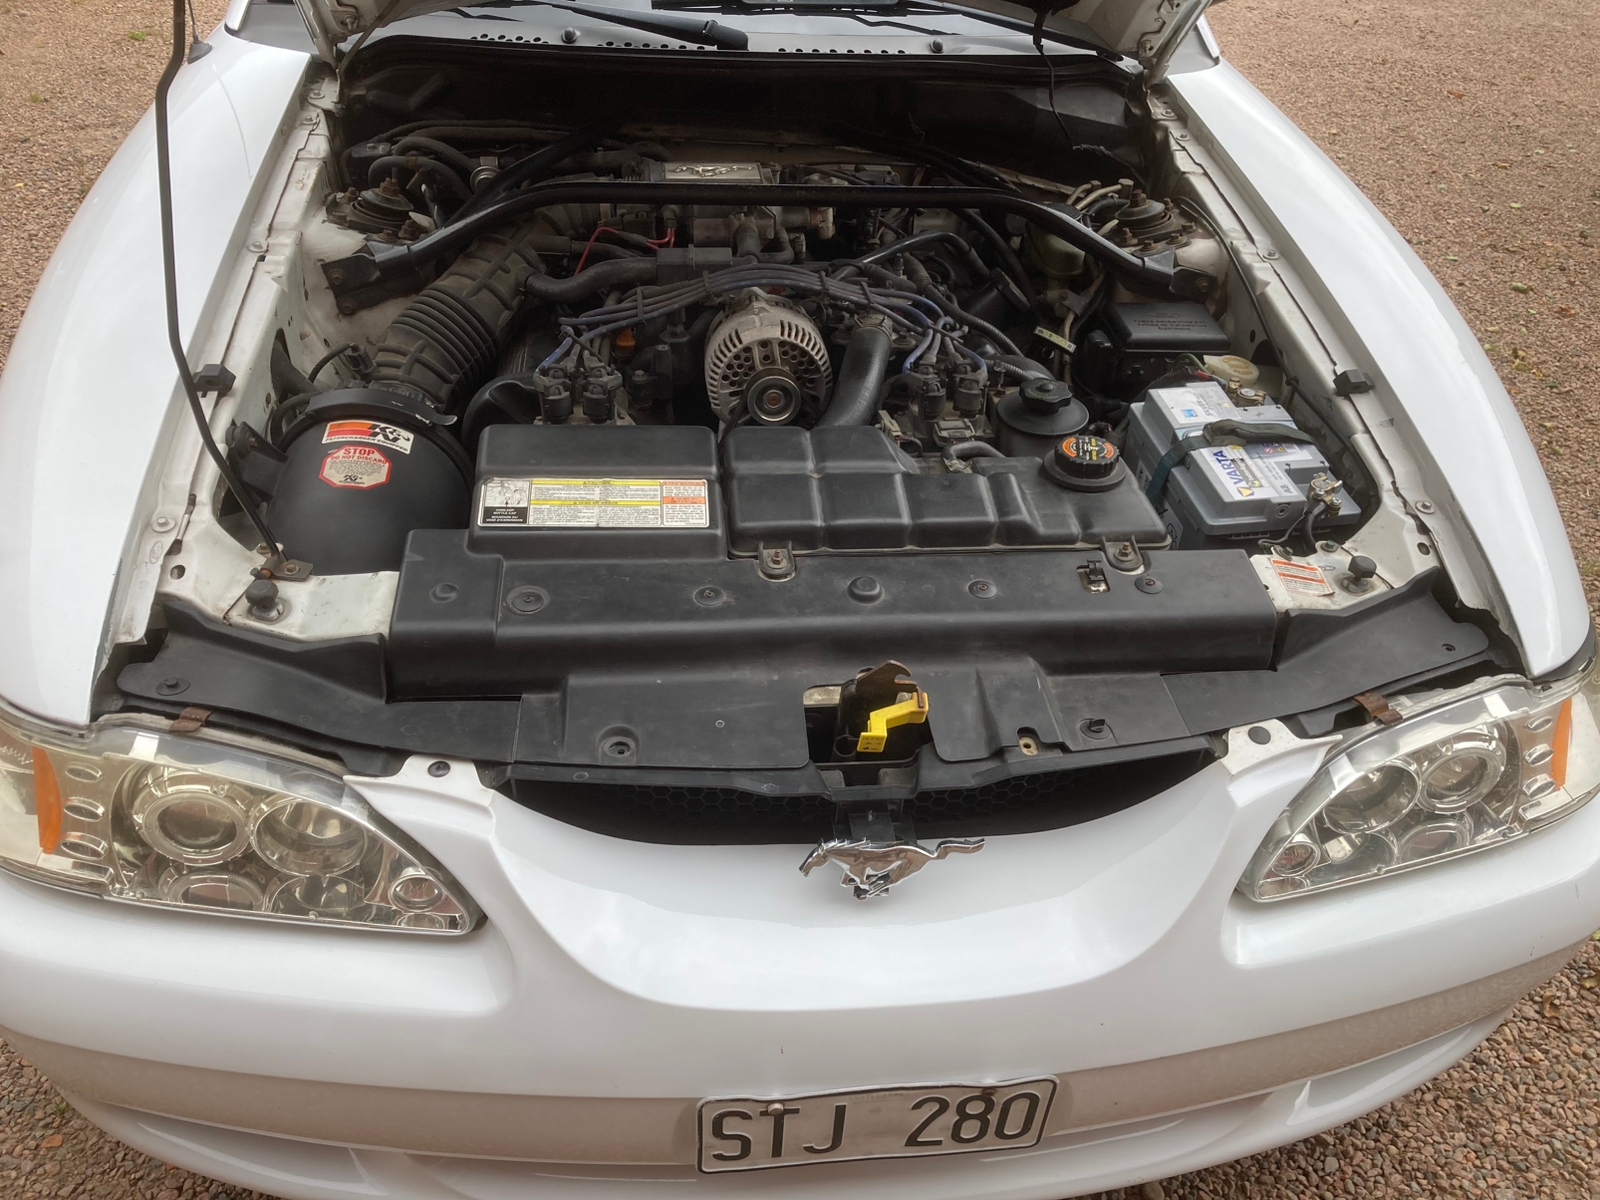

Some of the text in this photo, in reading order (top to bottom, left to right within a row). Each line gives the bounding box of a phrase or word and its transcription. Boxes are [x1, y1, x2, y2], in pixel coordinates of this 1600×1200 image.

[368, 424, 411, 443] K&N
[343, 448, 375, 456] STOP
[357, 455, 388, 464] DISCARD
[1212, 449, 1244, 485] VARTA
[711, 1091, 1041, 1161] STJ 280
